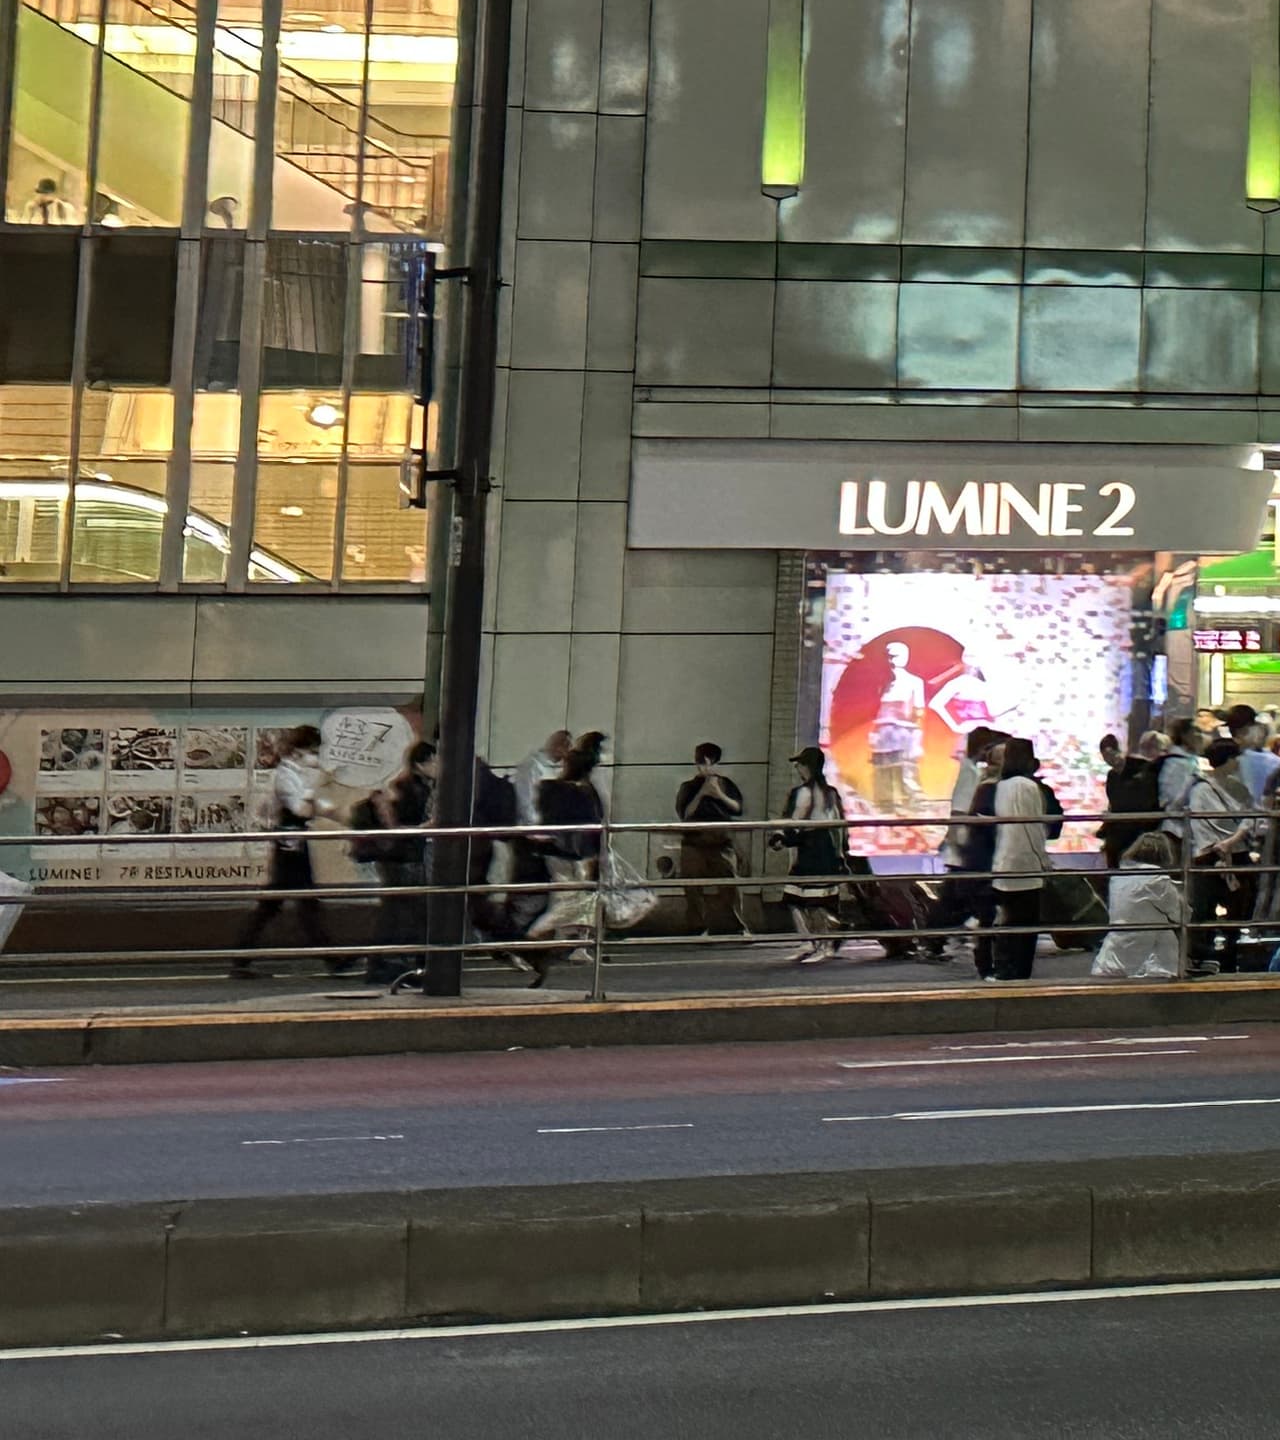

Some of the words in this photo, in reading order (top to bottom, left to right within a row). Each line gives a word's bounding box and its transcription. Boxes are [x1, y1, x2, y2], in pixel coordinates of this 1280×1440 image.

[838, 481, 1085, 536] LUMINE
[1093, 482, 1137, 536] 2
[143, 864, 250, 881] RESTAURANT
